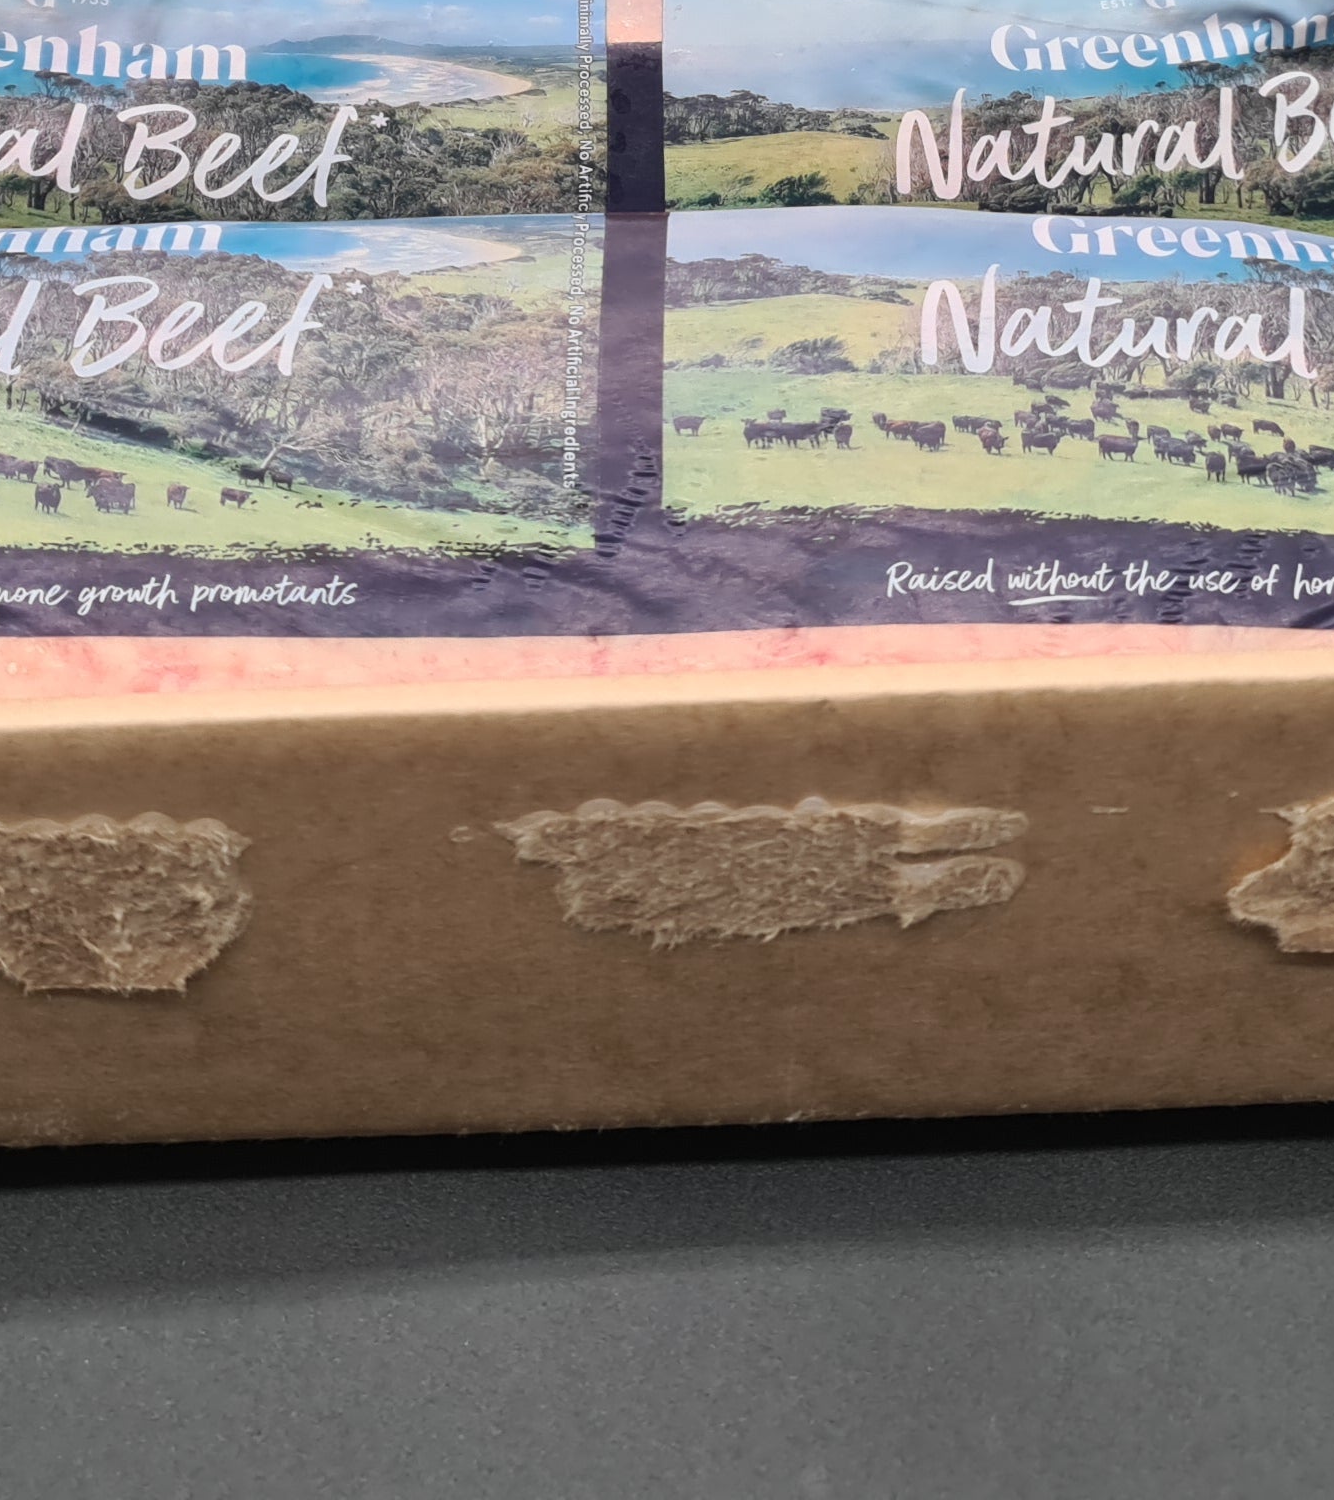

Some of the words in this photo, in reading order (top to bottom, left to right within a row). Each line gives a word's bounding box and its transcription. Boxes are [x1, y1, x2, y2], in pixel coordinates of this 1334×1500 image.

[578, 55, 593, 135] Processed,
[117, 103, 360, 207] Beef
[579, 140, 593, 161] No
[896, 87, 1244, 200] Natural
[579, 164, 593, 212] Artific
[568, 222, 590, 299] Processed,
[71, 274, 334, 378] Beef
[568, 306, 584, 325] No
[919, 264, 1317, 380] Natural
[566, 329, 583, 393] Artificial
[561, 394, 581, 489] Ingredients
[77, 574, 178, 616] growth
[190, 574, 358, 612] promotants
[886, 558, 995, 598] Raised
[1008, 560, 1115, 596] without
[1123, 560, 1179, 597] the
[1188, 571, 1241, 595] use
[1250, 564, 1279, 596] of
